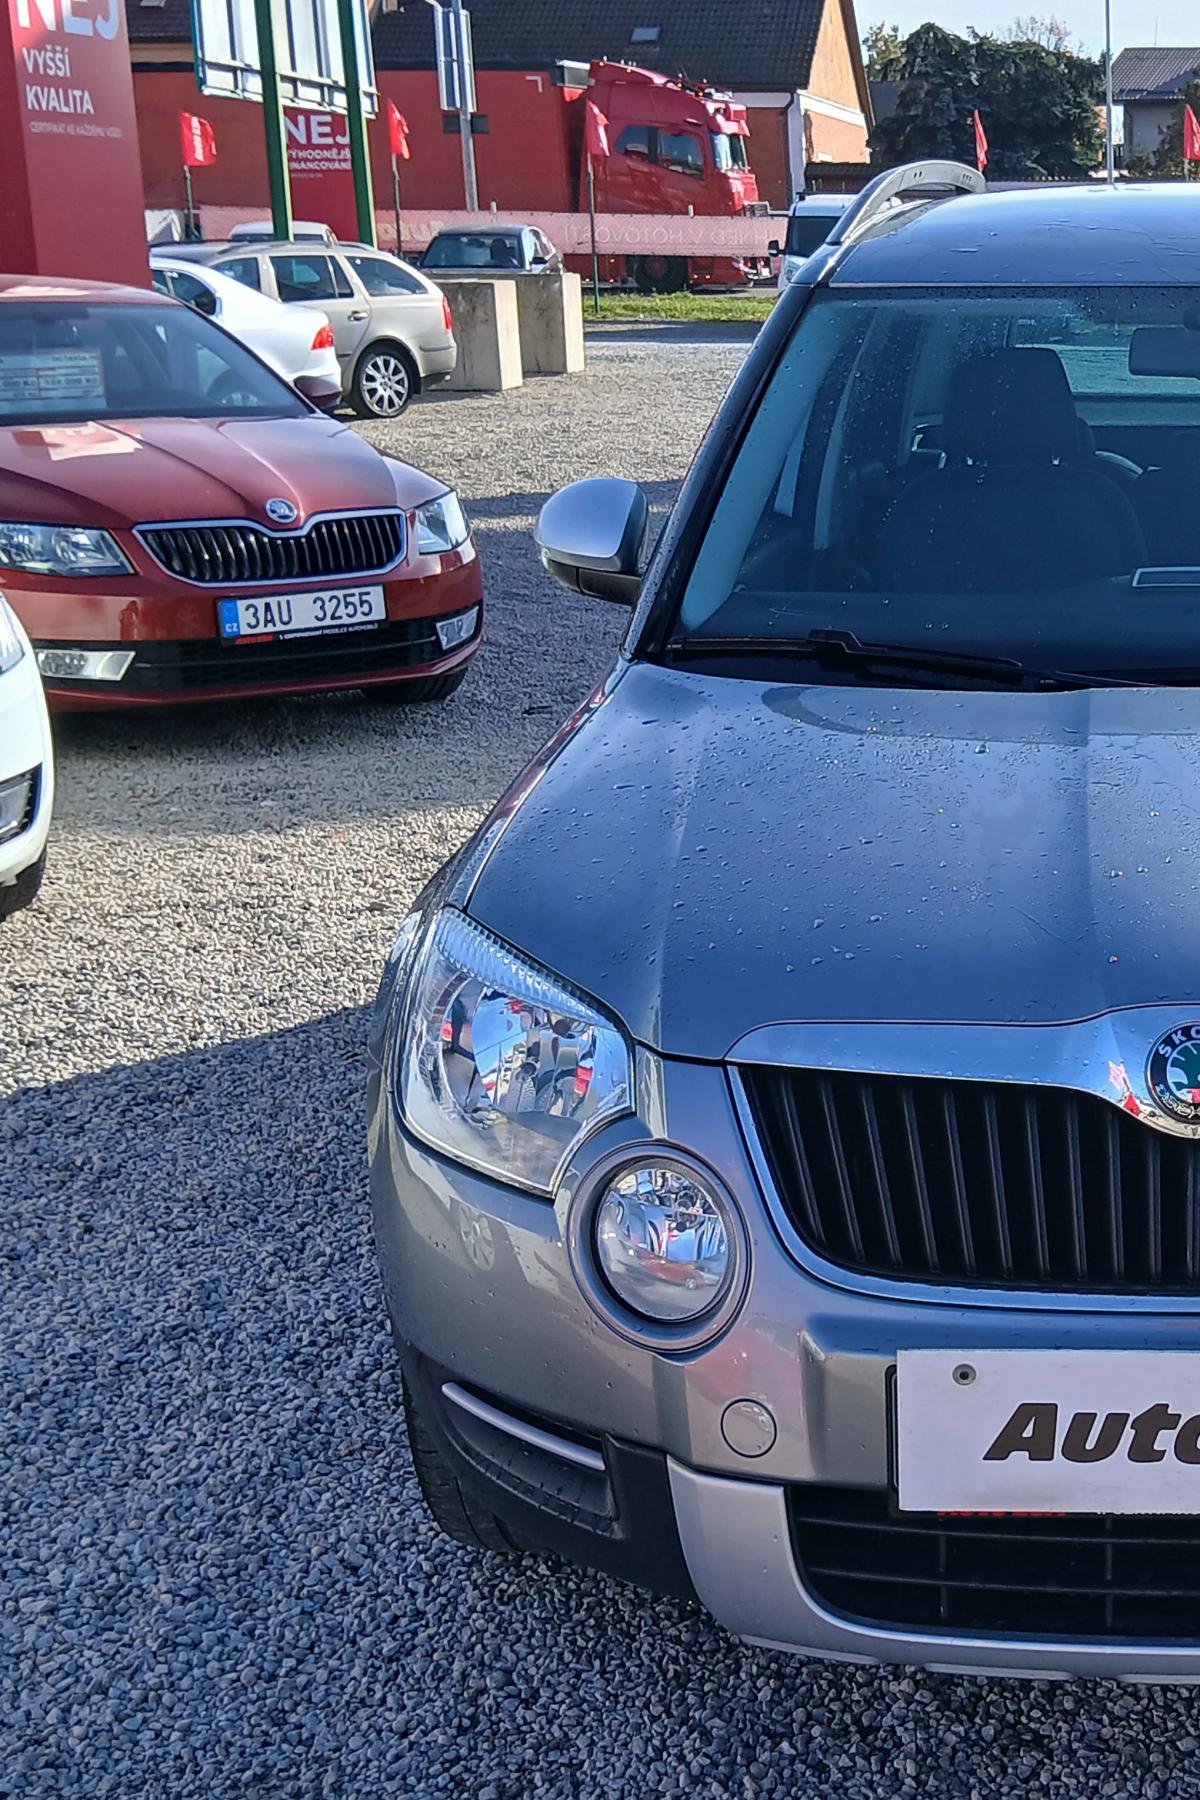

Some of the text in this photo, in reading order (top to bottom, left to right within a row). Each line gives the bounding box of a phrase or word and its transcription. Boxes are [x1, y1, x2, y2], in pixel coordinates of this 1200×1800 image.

[22, 43, 72, 78] VYŠŠÍ
[25, 84, 95, 115] KVALITA
[244, 591, 373, 630] 3AU 3255
[225, 623, 239, 633] CZ
